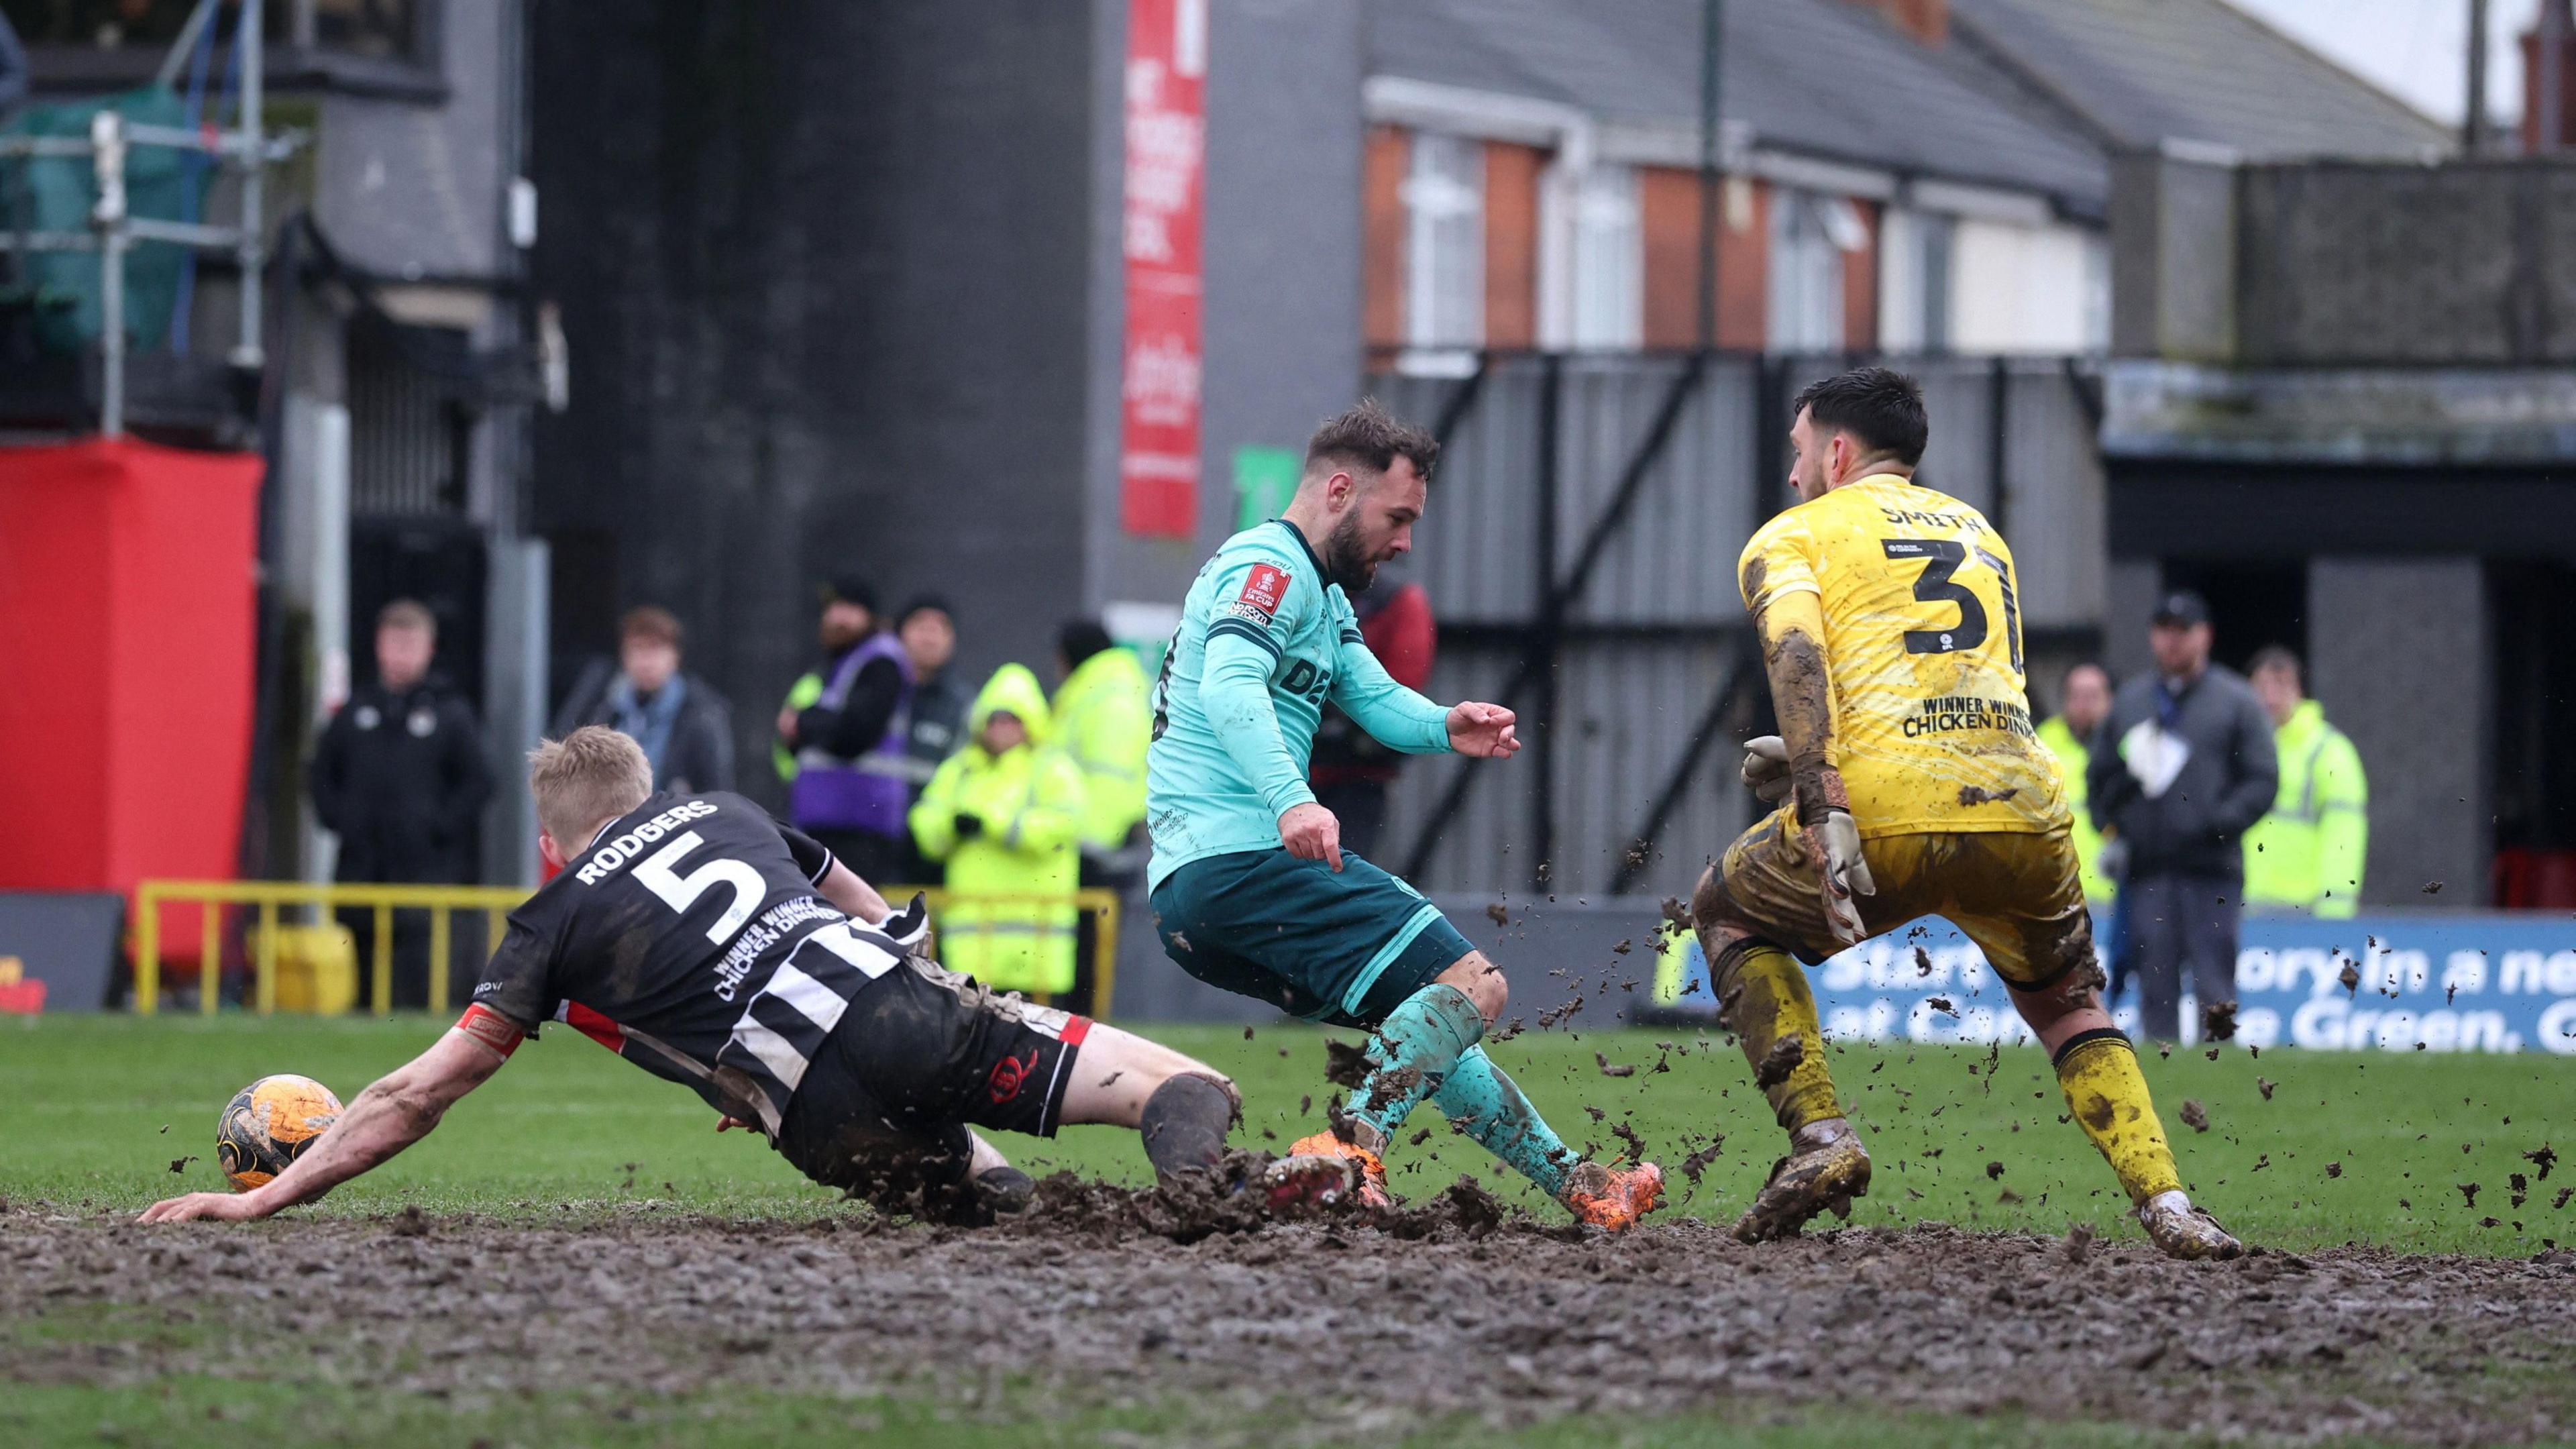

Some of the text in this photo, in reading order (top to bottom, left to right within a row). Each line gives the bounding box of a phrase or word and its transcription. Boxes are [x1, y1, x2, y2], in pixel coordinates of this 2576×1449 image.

[1880, 507, 1986, 536] SMITH
[1231, 602, 1269, 625] No room
[1244, 593, 1273, 608] FA CUP
[1247, 588, 1275, 602] Emirates
[1880, 539, 2022, 675] 31
[1902, 713, 1992, 738] CHICKEN
[1923, 696, 2031, 724] WINNER WINNE
[575, 800, 718, 885] RODGERS
[630, 830, 767, 946] 5
[713, 896, 816, 976] WINNER WINNER
[714, 927, 781, 1002] CHICKEN
[2233, 945, 2352, 998] ory
